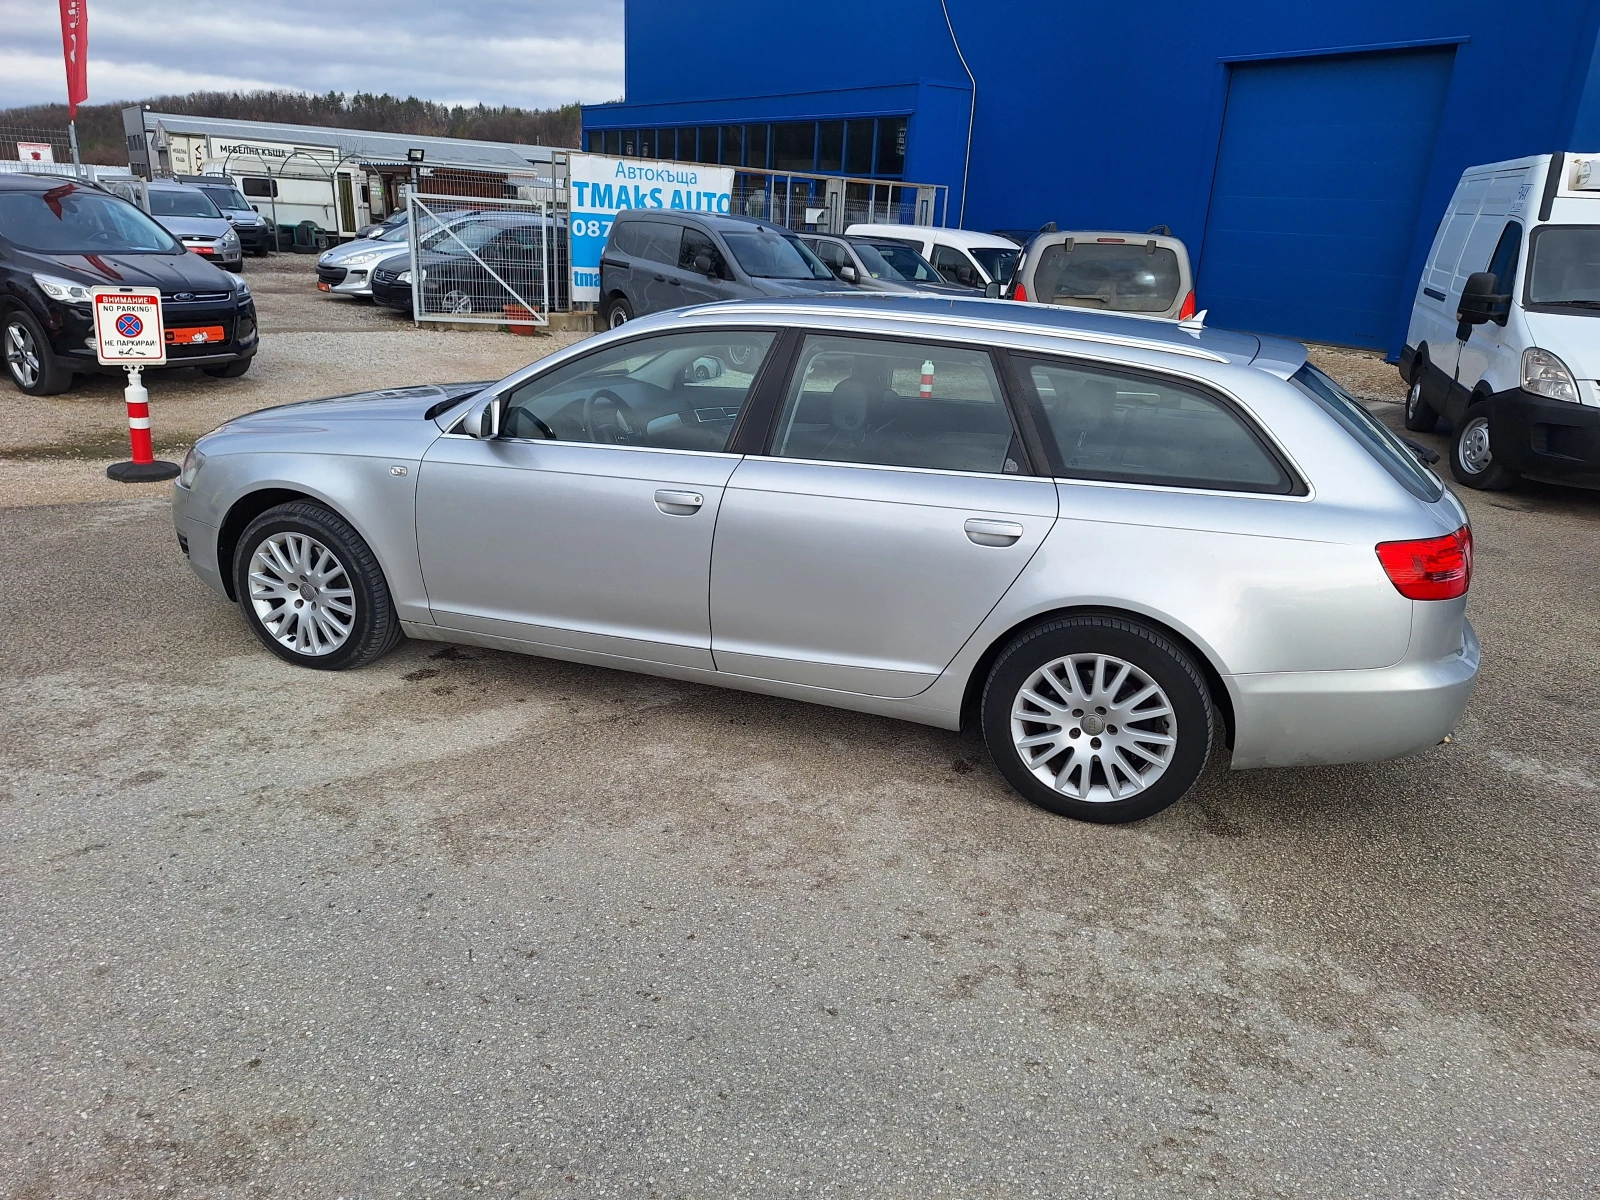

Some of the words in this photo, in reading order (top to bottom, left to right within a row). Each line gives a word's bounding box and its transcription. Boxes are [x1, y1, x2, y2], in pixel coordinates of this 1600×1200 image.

[219, 144, 259, 156] МЕБЕЛНА
[615, 161, 698, 187] Автокъща
[670, 189, 731, 214] AUTO
[102, 296, 151, 304] ВНИМАНИЕ!
[116, 339, 157, 347] ПАРКИРАЙ!
